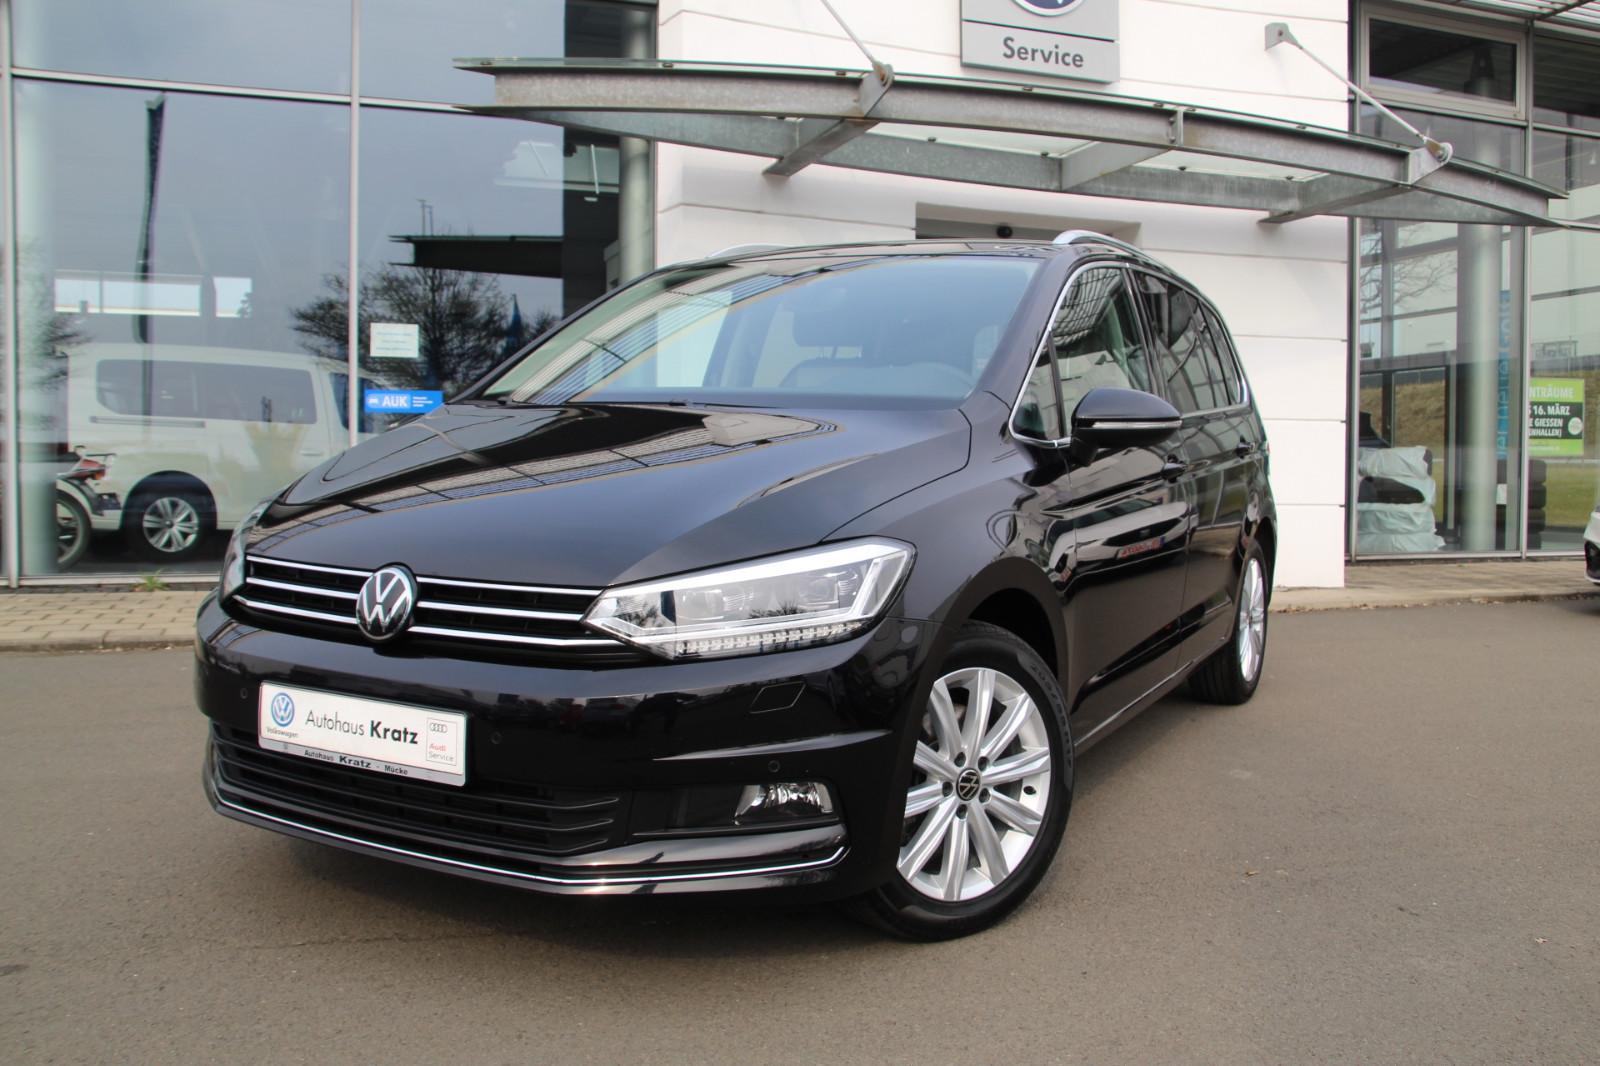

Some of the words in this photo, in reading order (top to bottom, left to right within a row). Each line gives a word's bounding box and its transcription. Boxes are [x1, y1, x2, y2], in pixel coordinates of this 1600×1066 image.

[1002, 36, 1084, 68] Service
[382, 395, 408, 408] AUK
[1533, 405, 1546, 415] 16.
[1547, 403, 1570, 415] MÄRZ
[1534, 418, 1563, 427] GIESSEN
[305, 710, 365, 736] Autohaus
[370, 720, 418, 744] Kratz
[429, 743, 446, 751] Audi
[304, 750, 334, 761] Autohaus
[339, 755, 371, 769] Kratz
[429, 751, 454, 762] Service
